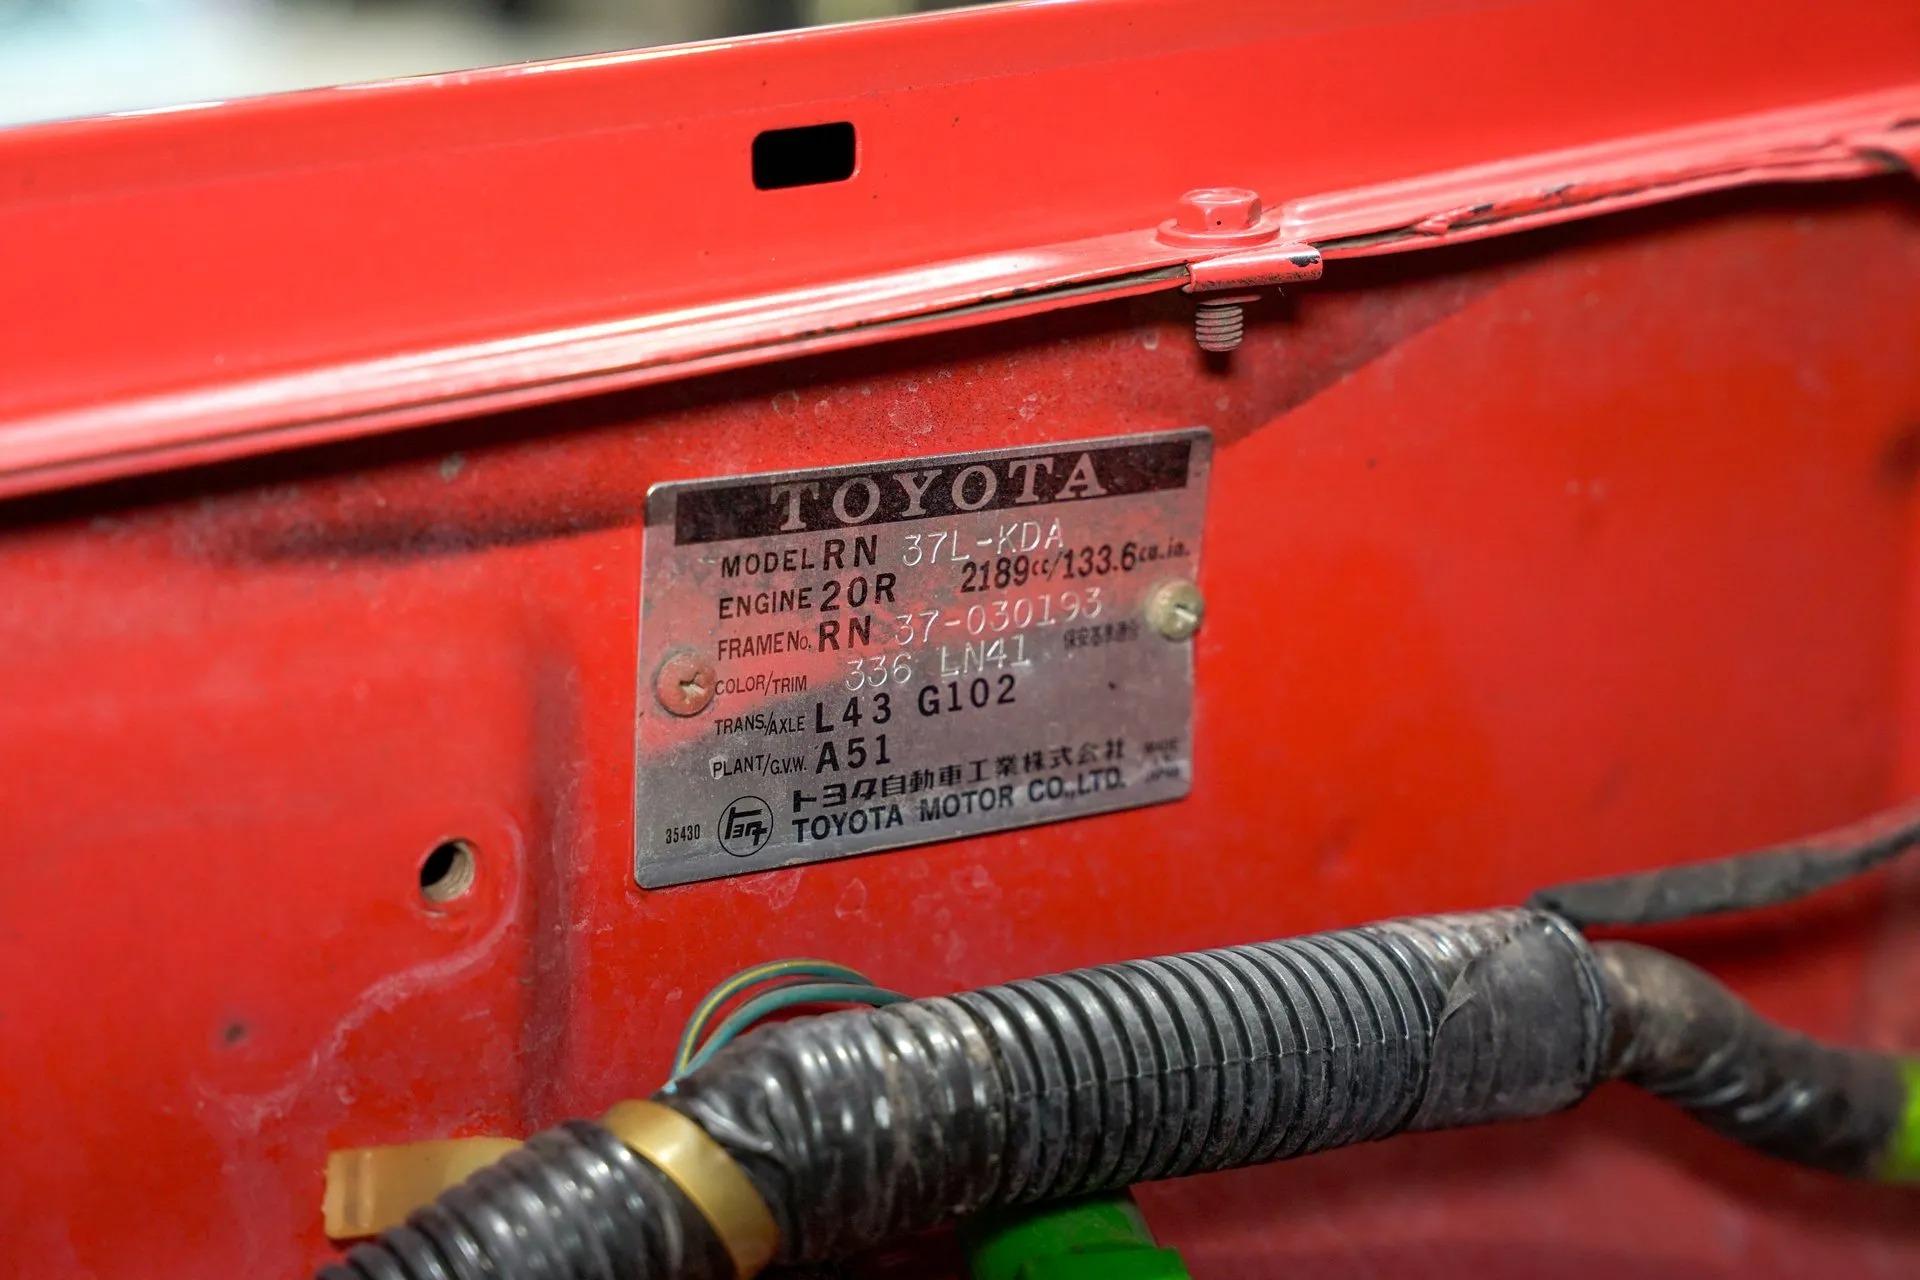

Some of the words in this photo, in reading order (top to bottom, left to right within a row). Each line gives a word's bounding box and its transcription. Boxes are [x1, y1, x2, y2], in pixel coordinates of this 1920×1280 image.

[769, 452, 1108, 532] TOYOTA
[721, 547, 815, 578] MODEL
[823, 534, 878, 571] RN
[902, 517, 1065, 567] 37L-KDA
[719, 586, 812, 620] ENGINE
[819, 572, 897, 612] 20R
[818, 615, 871, 653] RN
[895, 587, 1103, 646] 37-030193
[714, 670, 808, 697] COLOR/TRIM
[845, 653, 912, 691] 336
[815, 692, 892, 734] L43
[917, 673, 1017, 718] G102
[815, 734, 891, 775] A51
[665, 824, 701, 844] 35430
[791, 804, 904, 843] TOYOTA
[918, 784, 1014, 822] MOTOR
